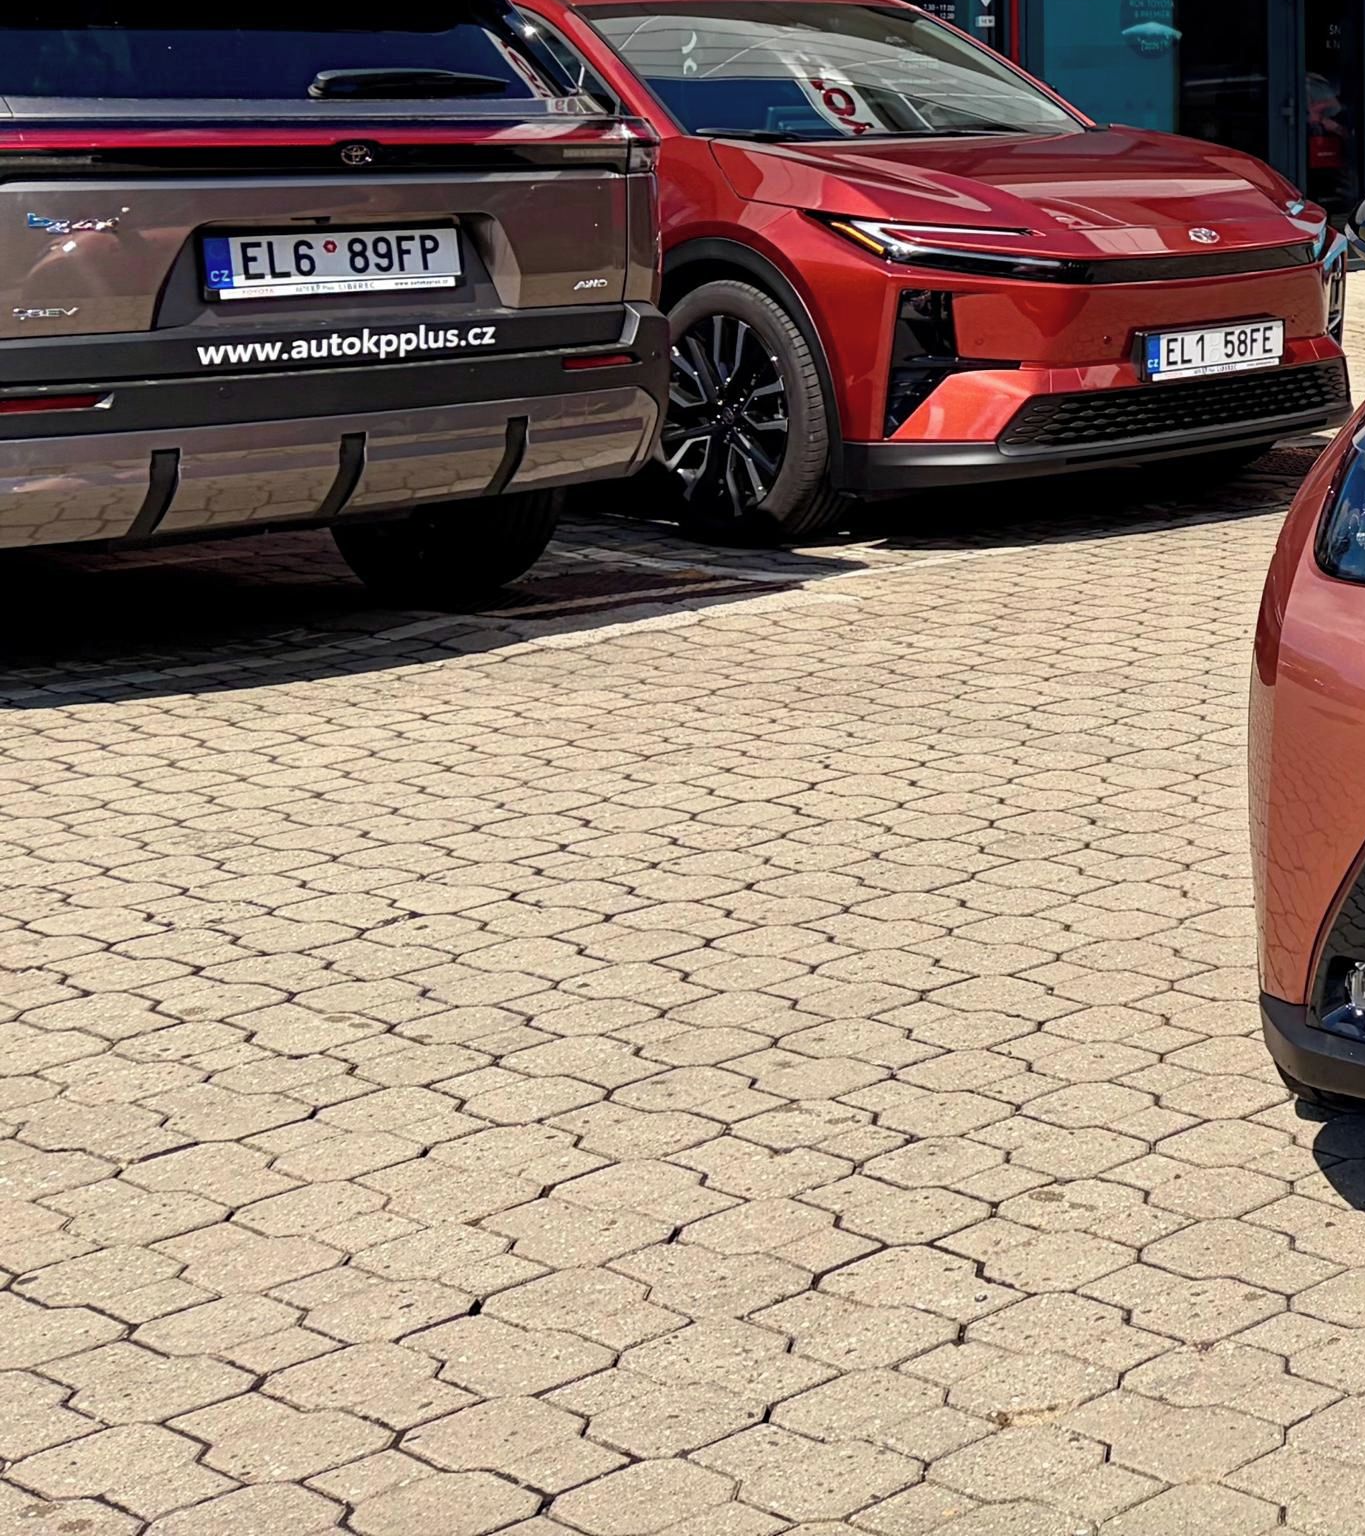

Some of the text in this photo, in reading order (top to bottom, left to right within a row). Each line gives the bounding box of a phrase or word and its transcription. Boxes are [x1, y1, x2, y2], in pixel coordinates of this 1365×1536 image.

[210, 270, 231, 282] CZ
[240, 234, 440, 280] EL6 89FP
[197, 325, 496, 365] www.autokpplus.cz
[1147, 359, 1159, 369] CZ
[1166, 326, 1274, 367] EL1 58FE
